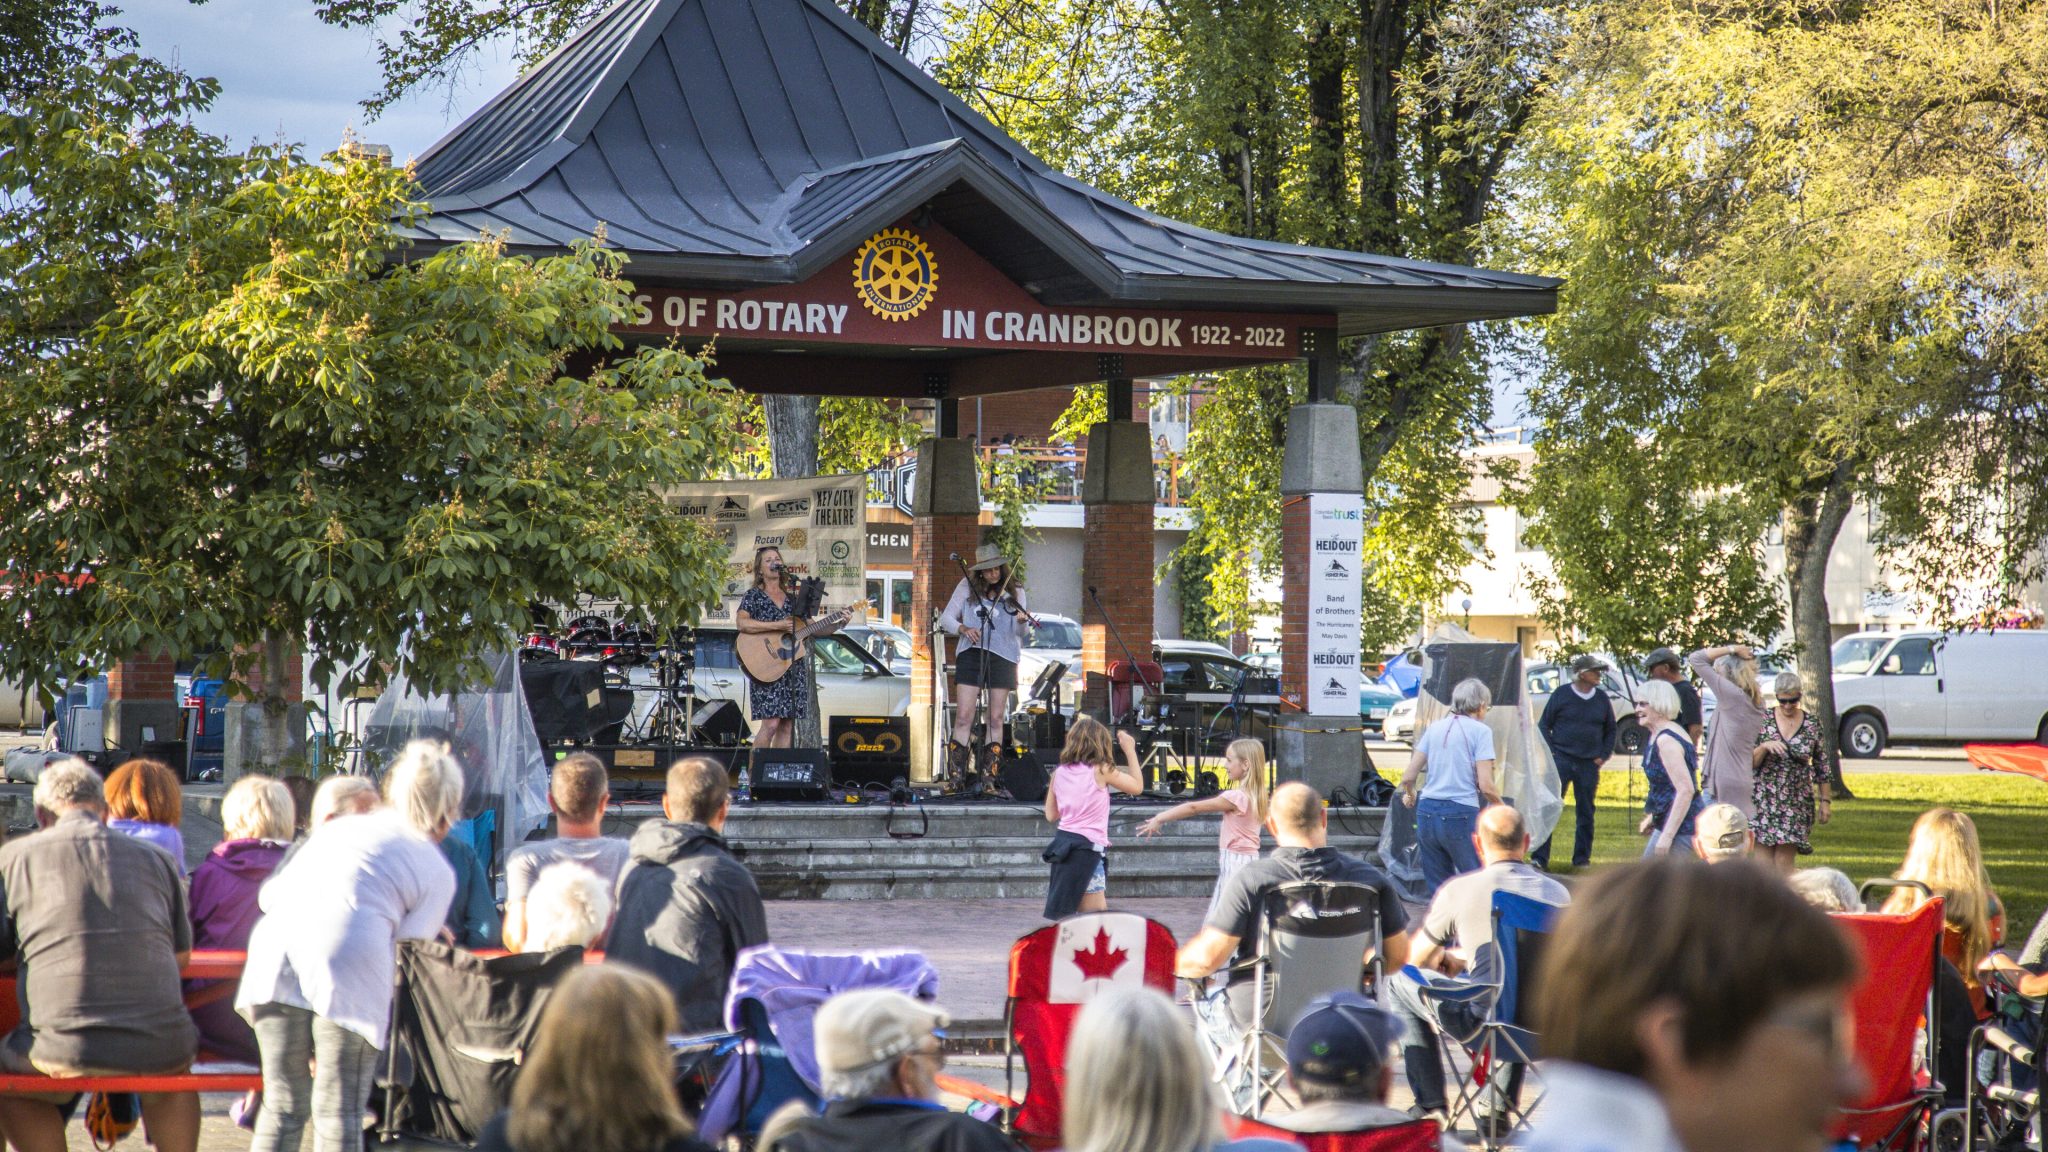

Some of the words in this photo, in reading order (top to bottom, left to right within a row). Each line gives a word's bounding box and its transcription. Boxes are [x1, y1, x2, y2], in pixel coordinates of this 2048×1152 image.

[879, 239, 914, 250] ROTARY
[866, 286, 925, 312] INTERNATIONAL
[663, 297, 707, 327] OF
[717, 299, 848, 334] ROTARY
[942, 309, 975, 339] IN
[985, 311, 1182, 347] CRANBROOK
[816, 491, 833, 507] KEY
[833, 489, 854, 507] CITY
[815, 508, 854, 525] THEATRE
[1334, 508, 1359, 520] trust
[754, 535, 785, 546] Rotary
[866, 533, 909, 547] CHEN
[1316, 541, 1357, 551] HEIDOUT
[1326, 594, 1345, 602] Band
[1315, 607, 1324, 615] of
[1325, 607, 1355, 615] Brothers
[1313, 654, 1355, 665] HEIDOUT
